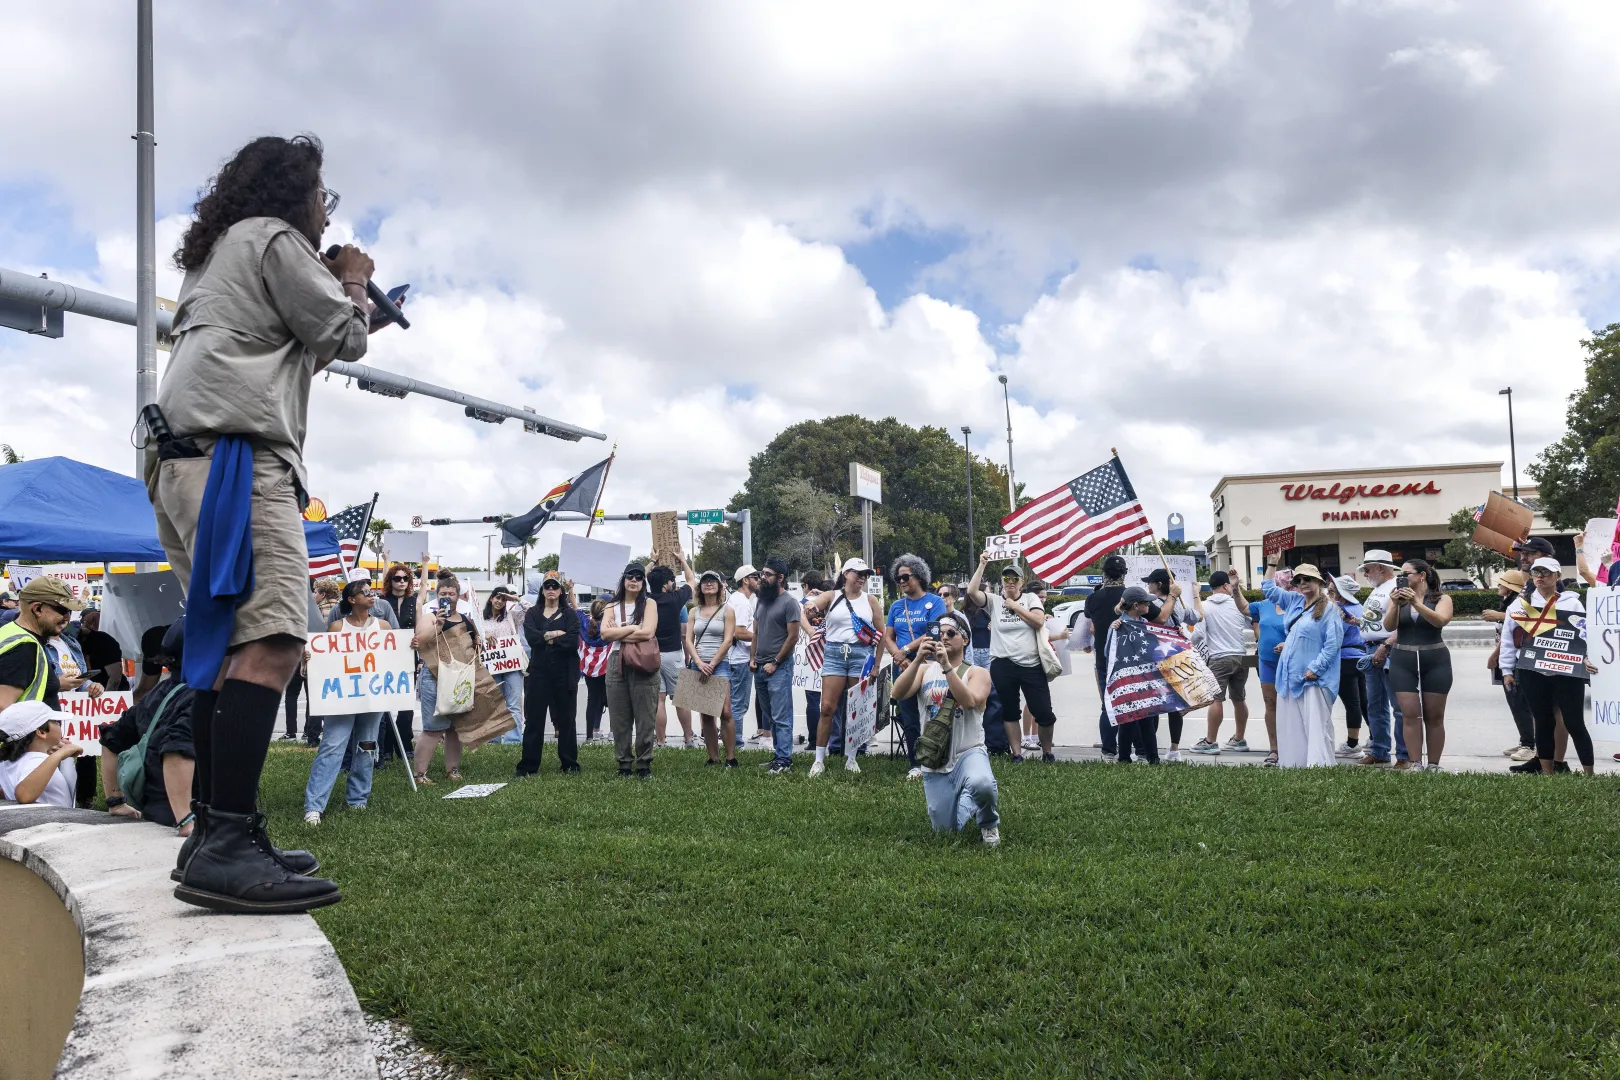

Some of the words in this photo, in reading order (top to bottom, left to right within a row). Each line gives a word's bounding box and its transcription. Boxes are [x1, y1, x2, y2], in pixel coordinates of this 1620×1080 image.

[1280, 480, 1441, 504] Walgreens
[1322, 509, 1399, 522] PHARMACY
[987, 534, 1020, 547] ICE
[1555, 629, 1573, 639] LIAR
[310, 632, 397, 653] CHINGA
[500, 637, 517, 649] WE
[1536, 639, 1568, 650] PERVERT
[481, 650, 507, 662] PROTE
[1546, 651, 1582, 663] COWARD
[344, 652, 376, 674] LA
[494, 658, 521, 671] HONK
[1538, 661, 1572, 671] THIEF
[321, 671, 410, 699] MIGRA
